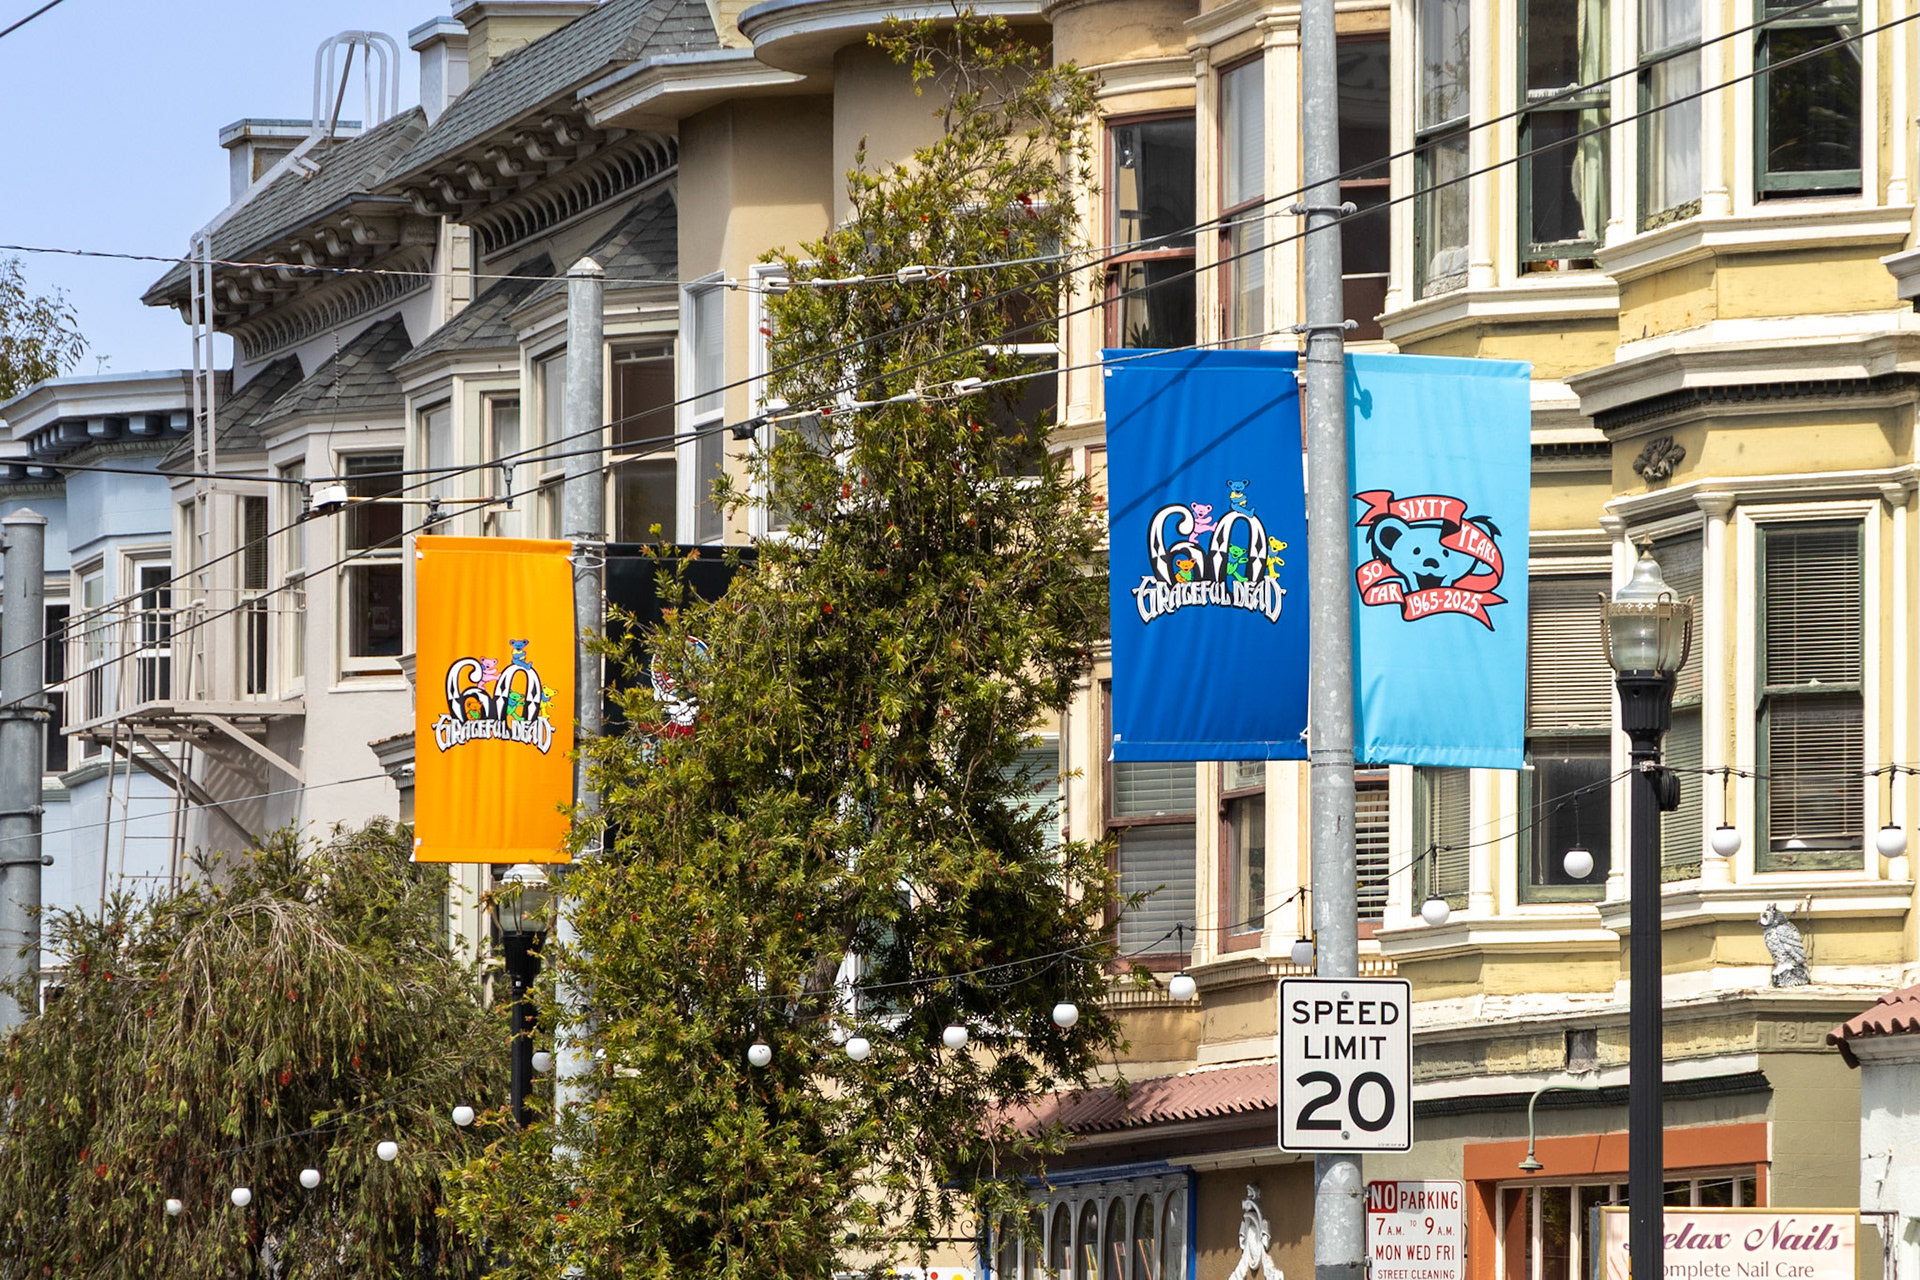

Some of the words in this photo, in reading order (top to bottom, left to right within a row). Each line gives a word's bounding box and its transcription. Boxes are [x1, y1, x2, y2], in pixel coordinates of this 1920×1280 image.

[1398, 499, 1451, 520] SIXTY
[1147, 504, 1269, 584] 60
[1457, 523, 1496, 564] YEARS
[1363, 563, 1383, 586] SO
[1232, 575, 1287, 624] DEAD
[1369, 582, 1403, 603] FAR
[1408, 591, 1482, 616] 1965-2025
[446, 657, 541, 722] 60
[511, 715, 556, 754] DEAD
[1292, 1000, 1399, 1025] SPEED
[1304, 1036, 1386, 1060] LIMIT
[1296, 1071, 1395, 1132] 20
[1370, 1184, 1396, 1210] NO
[1400, 1191, 1458, 1210] PARKING
[1664, 1222, 1731, 1250] elax
[1744, 1219, 1839, 1251] Nails
[1376, 1246, 1401, 1260] MON
[1406, 1246, 1431, 1260] WED
[1437, 1246, 1454, 1260] FRI
[1378, 1270, 1408, 1279] STREET
[1411, 1270, 1455, 1280] CLEANING
[1664, 1260, 1731, 1280] omplete
[1737, 1262, 1769, 1278] Nail
[1776, 1262, 1814, 1278] Care
